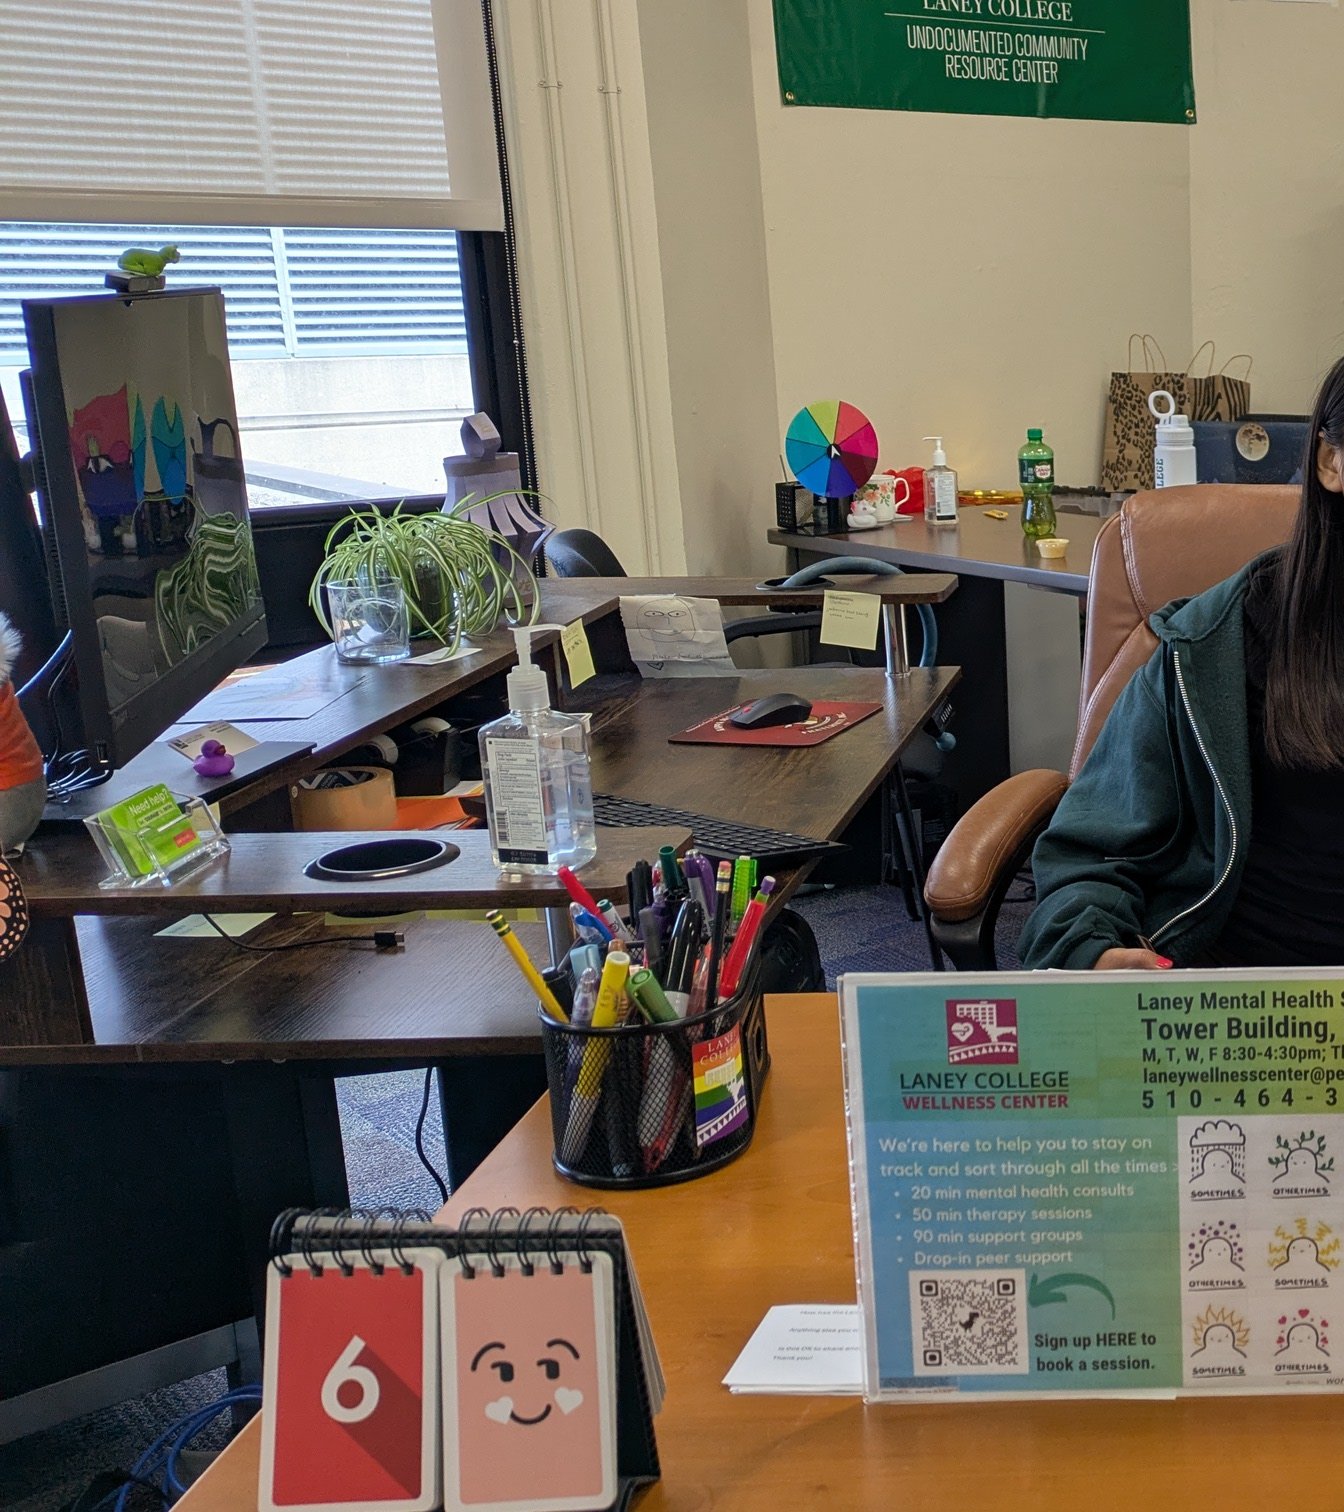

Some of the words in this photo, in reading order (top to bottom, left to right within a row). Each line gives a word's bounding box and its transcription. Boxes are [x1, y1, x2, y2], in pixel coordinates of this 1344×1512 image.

[988, 0, 1073, 21] COLLEGE
[907, 25, 1013, 55] UNDOCUMENTED
[1015, 34, 1088, 60] COMMUNITY
[945, 55, 1009, 81] RESOURCE
[1013, 59, 1058, 83] CENTER
[1156, 458, 1164, 487] LEGE
[128, 800, 150, 816] Need
[149, 788, 170, 809] help?
[1137, 993, 1193, 1014] Laney
[1200, 991, 1265, 1010] Mental
[1272, 990, 1334, 1008] Health
[1141, 1018, 1218, 1040] Tower
[1227, 1016, 1336, 1043] Building,
[1143, 1048, 1161, 1065] M,
[1165, 1048, 1181, 1064] T,
[1185, 1047, 1204, 1064] W,
[1209, 1047, 1218, 1062] F
[1223, 1045, 1326, 1065] 8:30-4:30pm;
[900, 1072, 968, 1090] LANEY
[974, 1070, 1070, 1089] COLLEGE
[902, 1095, 995, 1110] WELLNESS
[1001, 1094, 1069, 1109] CENTER
[878, 1138, 928, 1153] We're
[932, 1138, 970, 1152] here
[975, 1138, 992, 1152] to
[996, 1136, 1031, 1154] help
[1036, 1139, 1067, 1154] you
[1071, 1137, 1088, 1151] to
[1092, 1137, 1127, 1153] stay
[1132, 1138, 1152, 1150] on
[880, 1162, 923, 1177] track
[928, 1162, 960, 1177] and
[964, 1162, 995, 1176] sort
[1001, 1160, 1066, 1178] through
[1070, 1160, 1089, 1174] all
[1094, 1159, 1120, 1173] the
[1125, 1158, 1167, 1173] times
[911, 1186, 931, 1200] 20
[935, 1186, 961, 1199] min
[965, 1184, 1017, 1199] mental
[1021, 1183, 1067, 1198] health
[1072, 1183, 1135, 1197] consults
[1190, 1189, 1245, 1198] SOMETIMES
[1273, 1187, 1329, 1196] OTHERTIMES
[912, 1207, 932, 1222] 50
[936, 1207, 962, 1221] min
[967, 1207, 1027, 1223] therapy
[1031, 1207, 1093, 1220] sessions
[913, 1230, 933, 1243] 90
[937, 1229, 963, 1243] min
[968, 1230, 1026, 1245] support
[1031, 1230, 1083, 1244] groups
[914, 1252, 972, 1267] Drop-in
[976, 1253, 1010, 1267] peer
[1015, 1251, 1073, 1266] support
[1189, 1280, 1245, 1288] OTHERTIMES
[1275, 1278, 1328, 1287] SOMETIMES
[1034, 1333, 1068, 1350] Sign
[1073, 1335, 1092, 1350] up
[1096, 1332, 1137, 1347] HERE
[1141, 1333, 1157, 1346] to
[1037, 1357, 1074, 1372] book
[1079, 1360, 1087, 1371] a
[1092, 1357, 1155, 1371] session.
[1192, 1366, 1245, 1376] SOMETIMES
[1275, 1363, 1329, 1372] OTHERTIMES
[320, 1335, 381, 1424] 6
